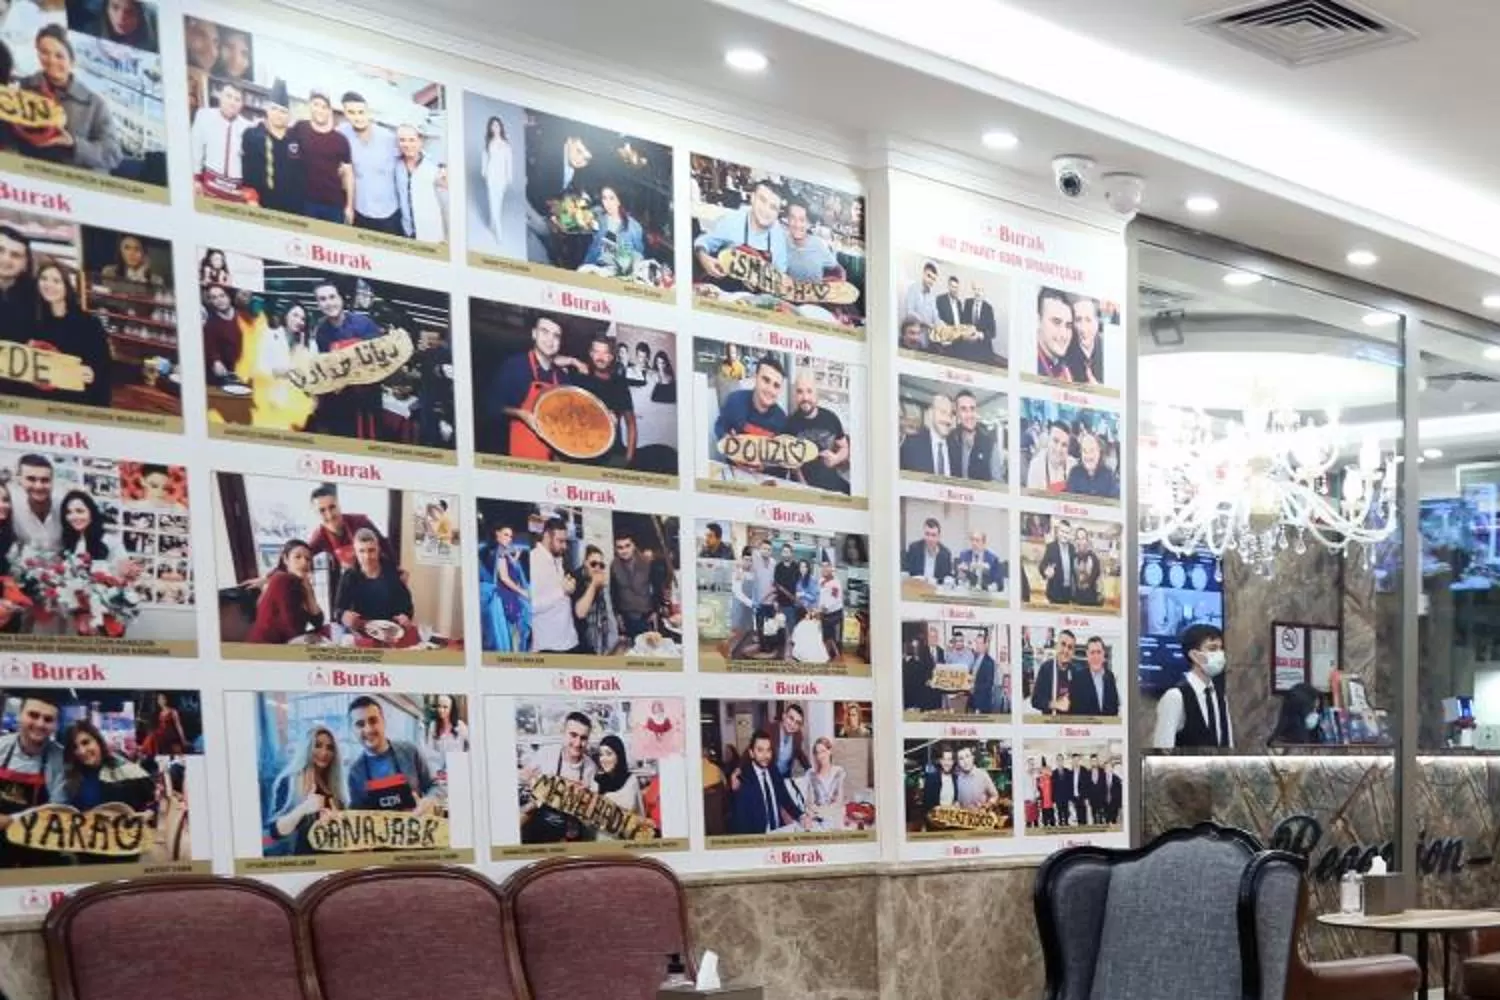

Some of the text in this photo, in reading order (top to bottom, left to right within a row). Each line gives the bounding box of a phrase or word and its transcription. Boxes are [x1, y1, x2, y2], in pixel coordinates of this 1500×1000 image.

[310, 244, 373, 271] Burak
[560, 292, 612, 315] Burak
[769, 331, 812, 351] Burak
[13, 424, 89, 450] Burak
[321, 459, 381, 481] Burak
[567, 485, 616, 505] Burak
[772, 507, 815, 525] Burak
[31, 661, 106, 681] Burak
[333, 670, 391, 687] Burak
[572, 676, 621, 691] Burak
[776, 681, 819, 695] Burak
[20, 810, 109, 851] YARA
[781, 849, 824, 864] Burak
